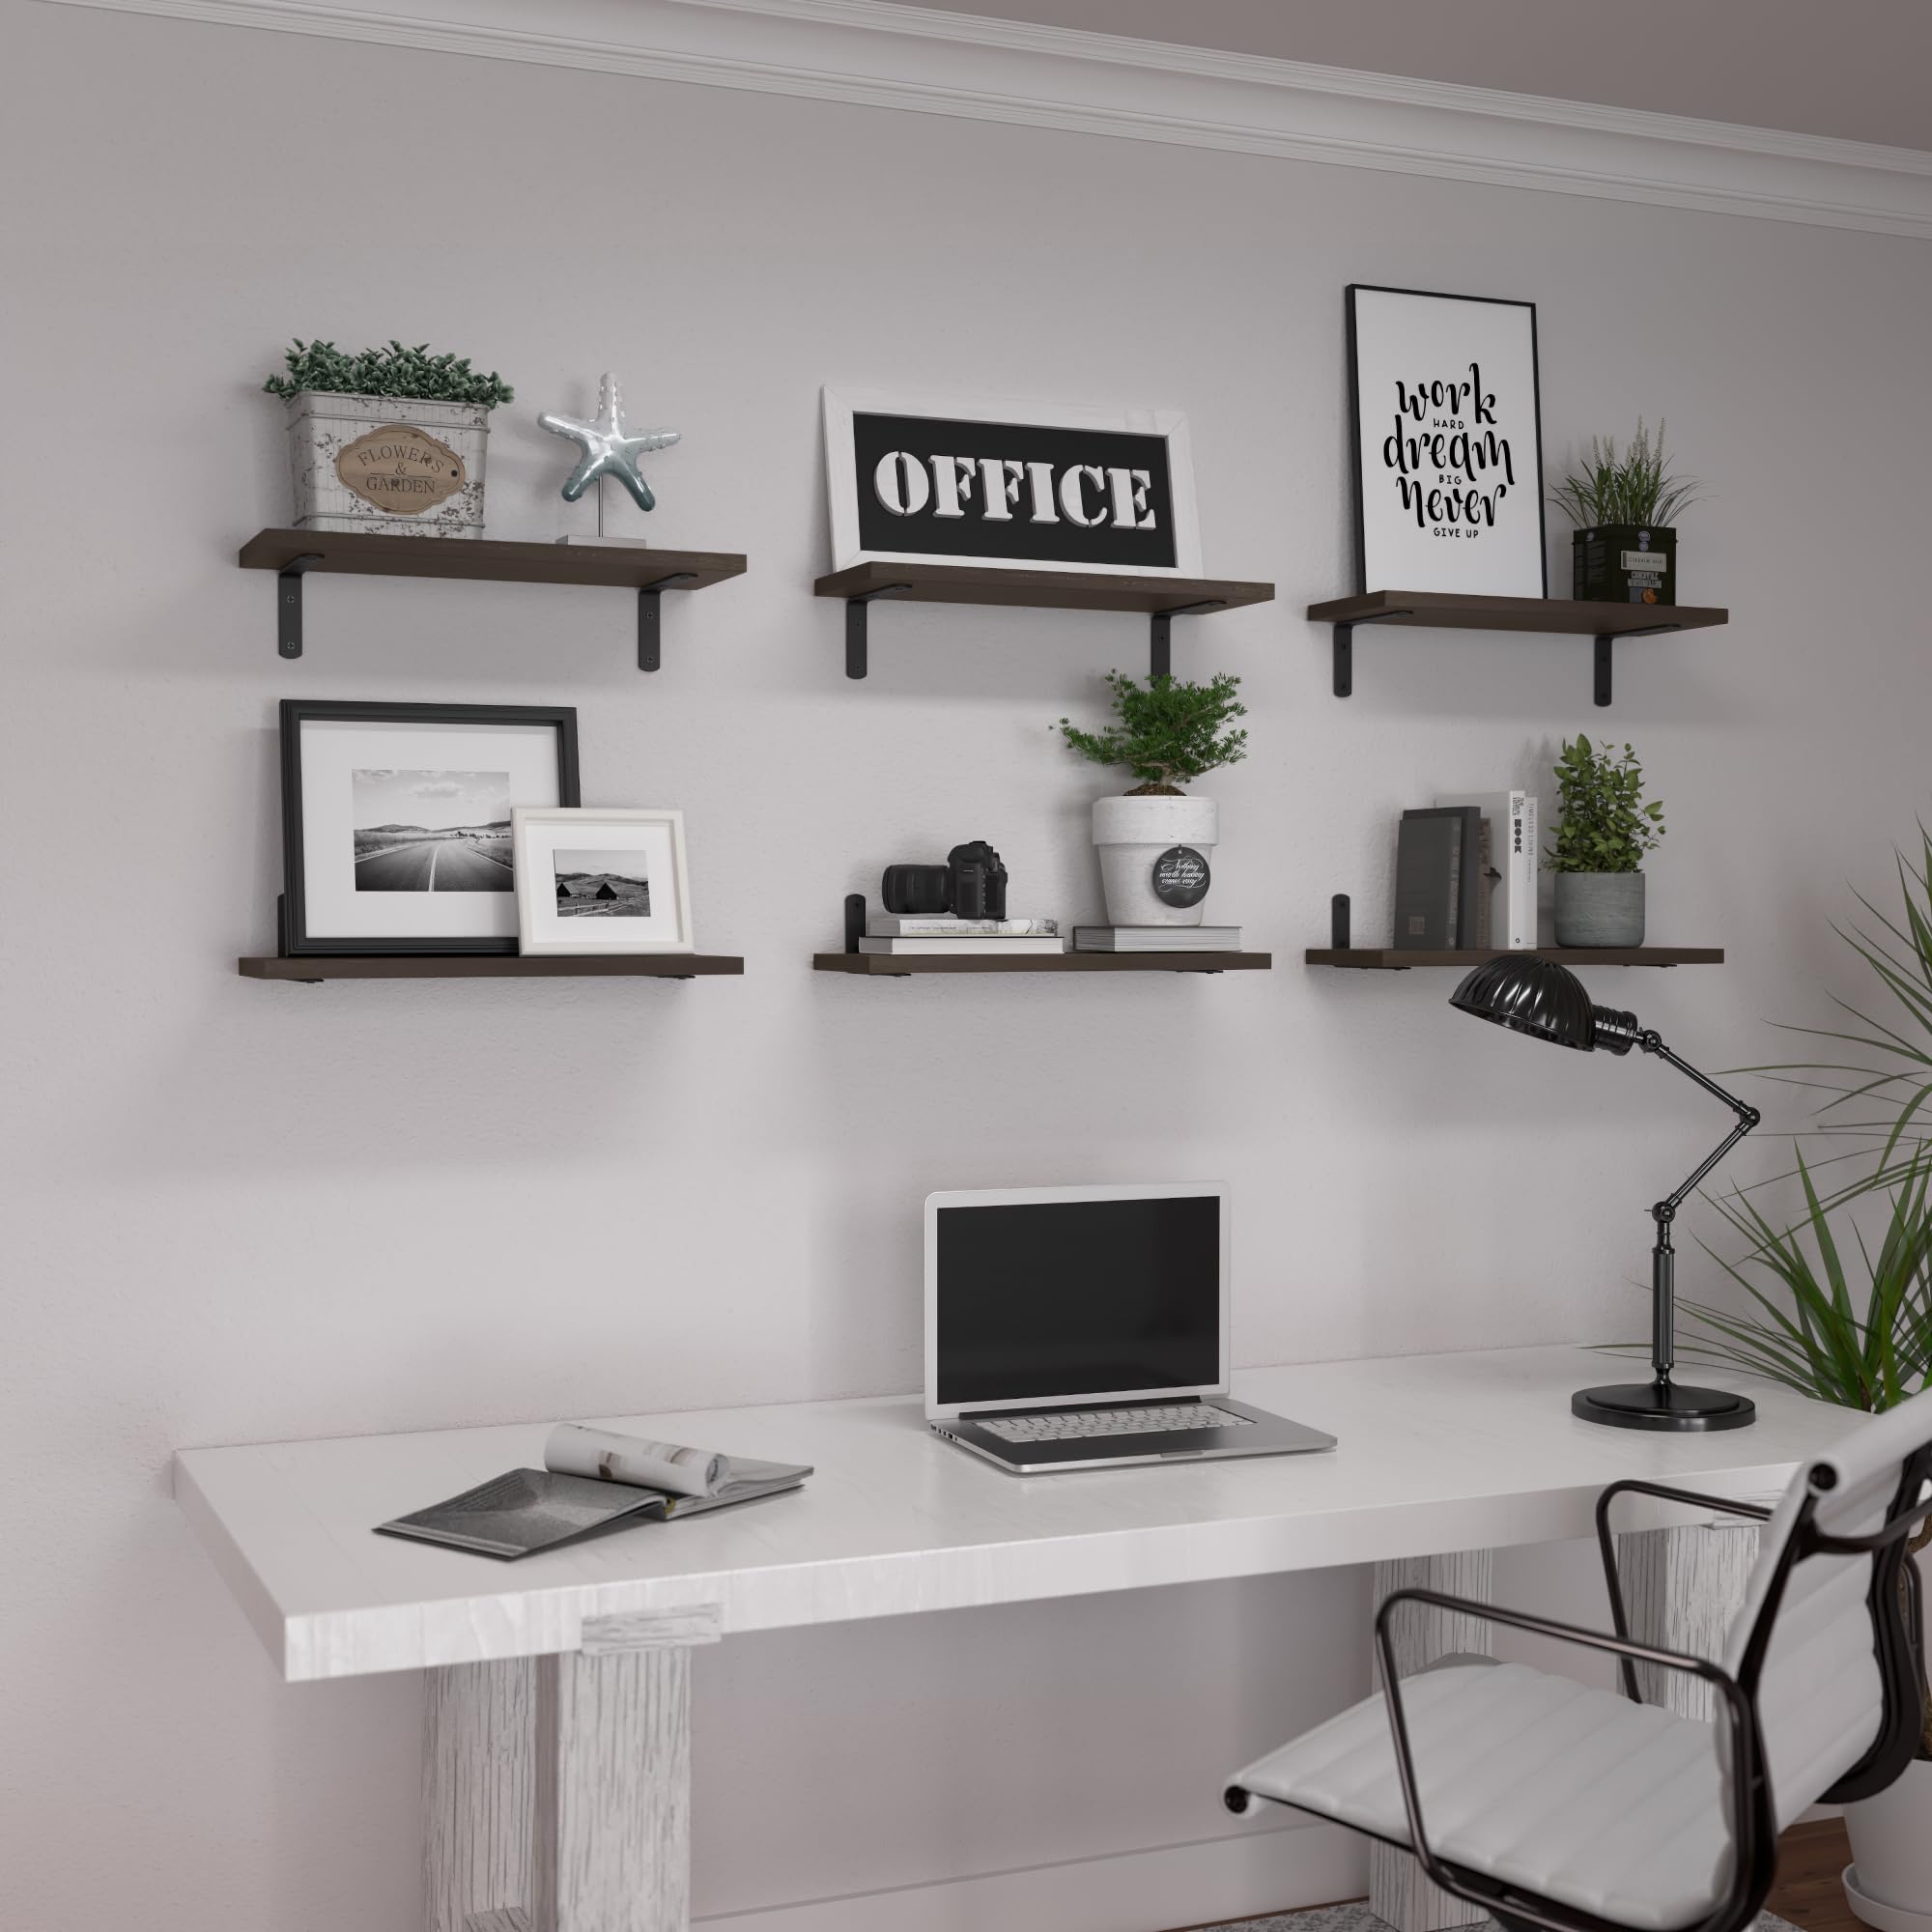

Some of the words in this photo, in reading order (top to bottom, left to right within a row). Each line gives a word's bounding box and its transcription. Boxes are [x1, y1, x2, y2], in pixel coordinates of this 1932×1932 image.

[1395, 363, 1497, 424] work
[1433, 418, 1464, 429] HARD
[1383, 413, 1516, 486] dream
[357, 444, 444, 474] FLOWERS
[395, 462, 407, 475] &
[366, 476, 435, 494] GARDEN
[1438, 474, 1462, 485] BIG
[873, 450, 1157, 531] OFFICE
[1434, 527, 1461, 538] GIVE
[1466, 529, 1479, 539] UP
